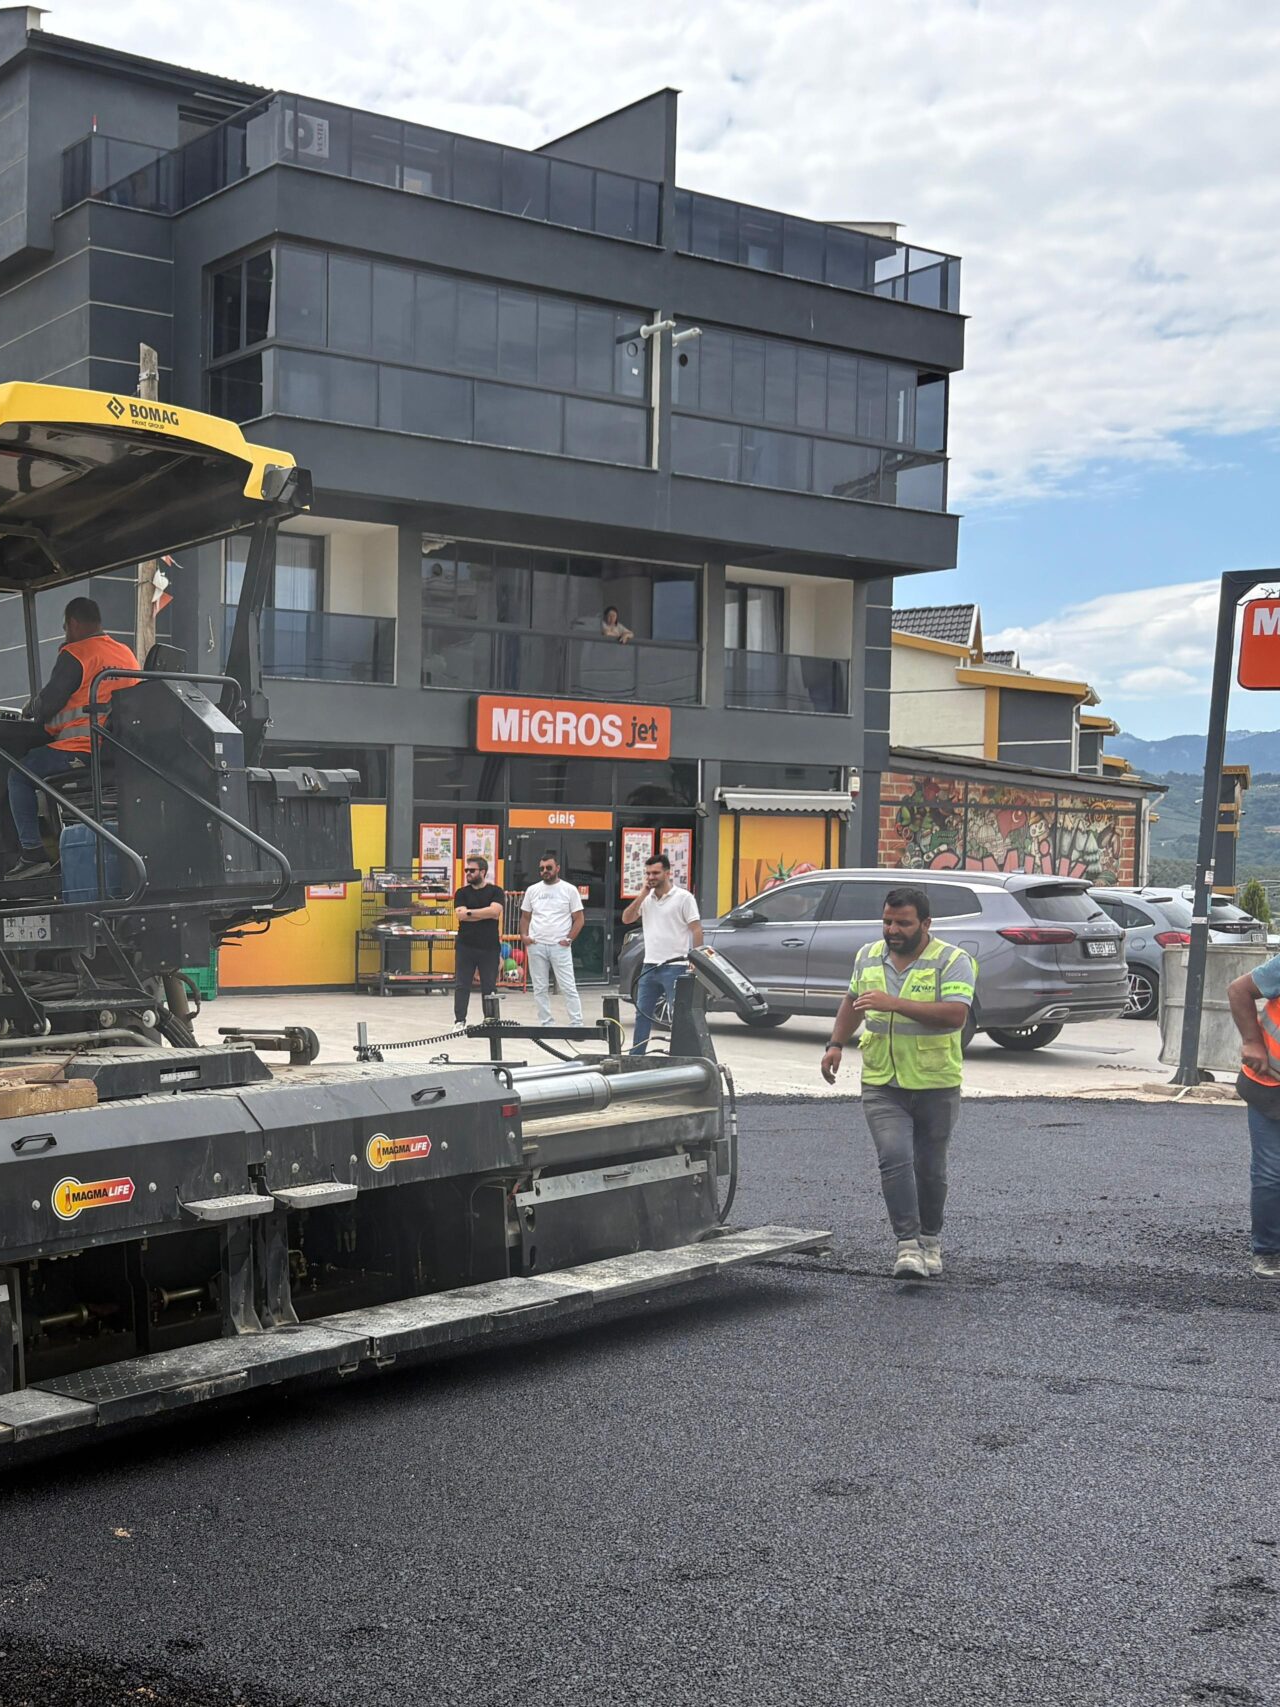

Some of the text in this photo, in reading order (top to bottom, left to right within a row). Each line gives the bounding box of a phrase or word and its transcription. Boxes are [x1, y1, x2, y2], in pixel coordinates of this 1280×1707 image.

[129, 403, 179, 426] BOMAG
[491, 707, 658, 748] MiGROS jet
[548, 810, 575, 827] GİRİŞ
